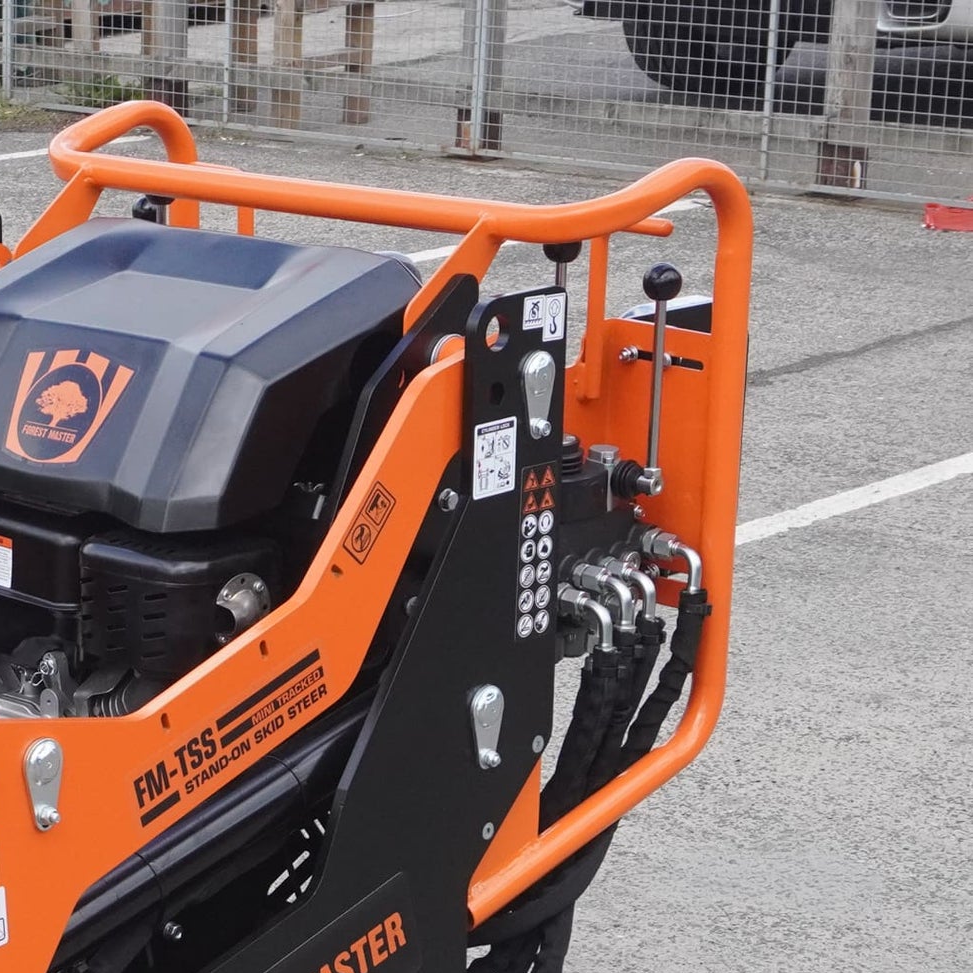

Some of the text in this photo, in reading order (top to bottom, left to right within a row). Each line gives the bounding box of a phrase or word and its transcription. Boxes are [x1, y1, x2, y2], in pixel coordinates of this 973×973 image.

[22, 424, 76, 444] FOREST MASTER
[252, 669, 321, 726] MINI TRACKED
[133, 727, 217, 809] FM-TSS
[185, 683, 328, 794] STAND-ON SKID STEER
